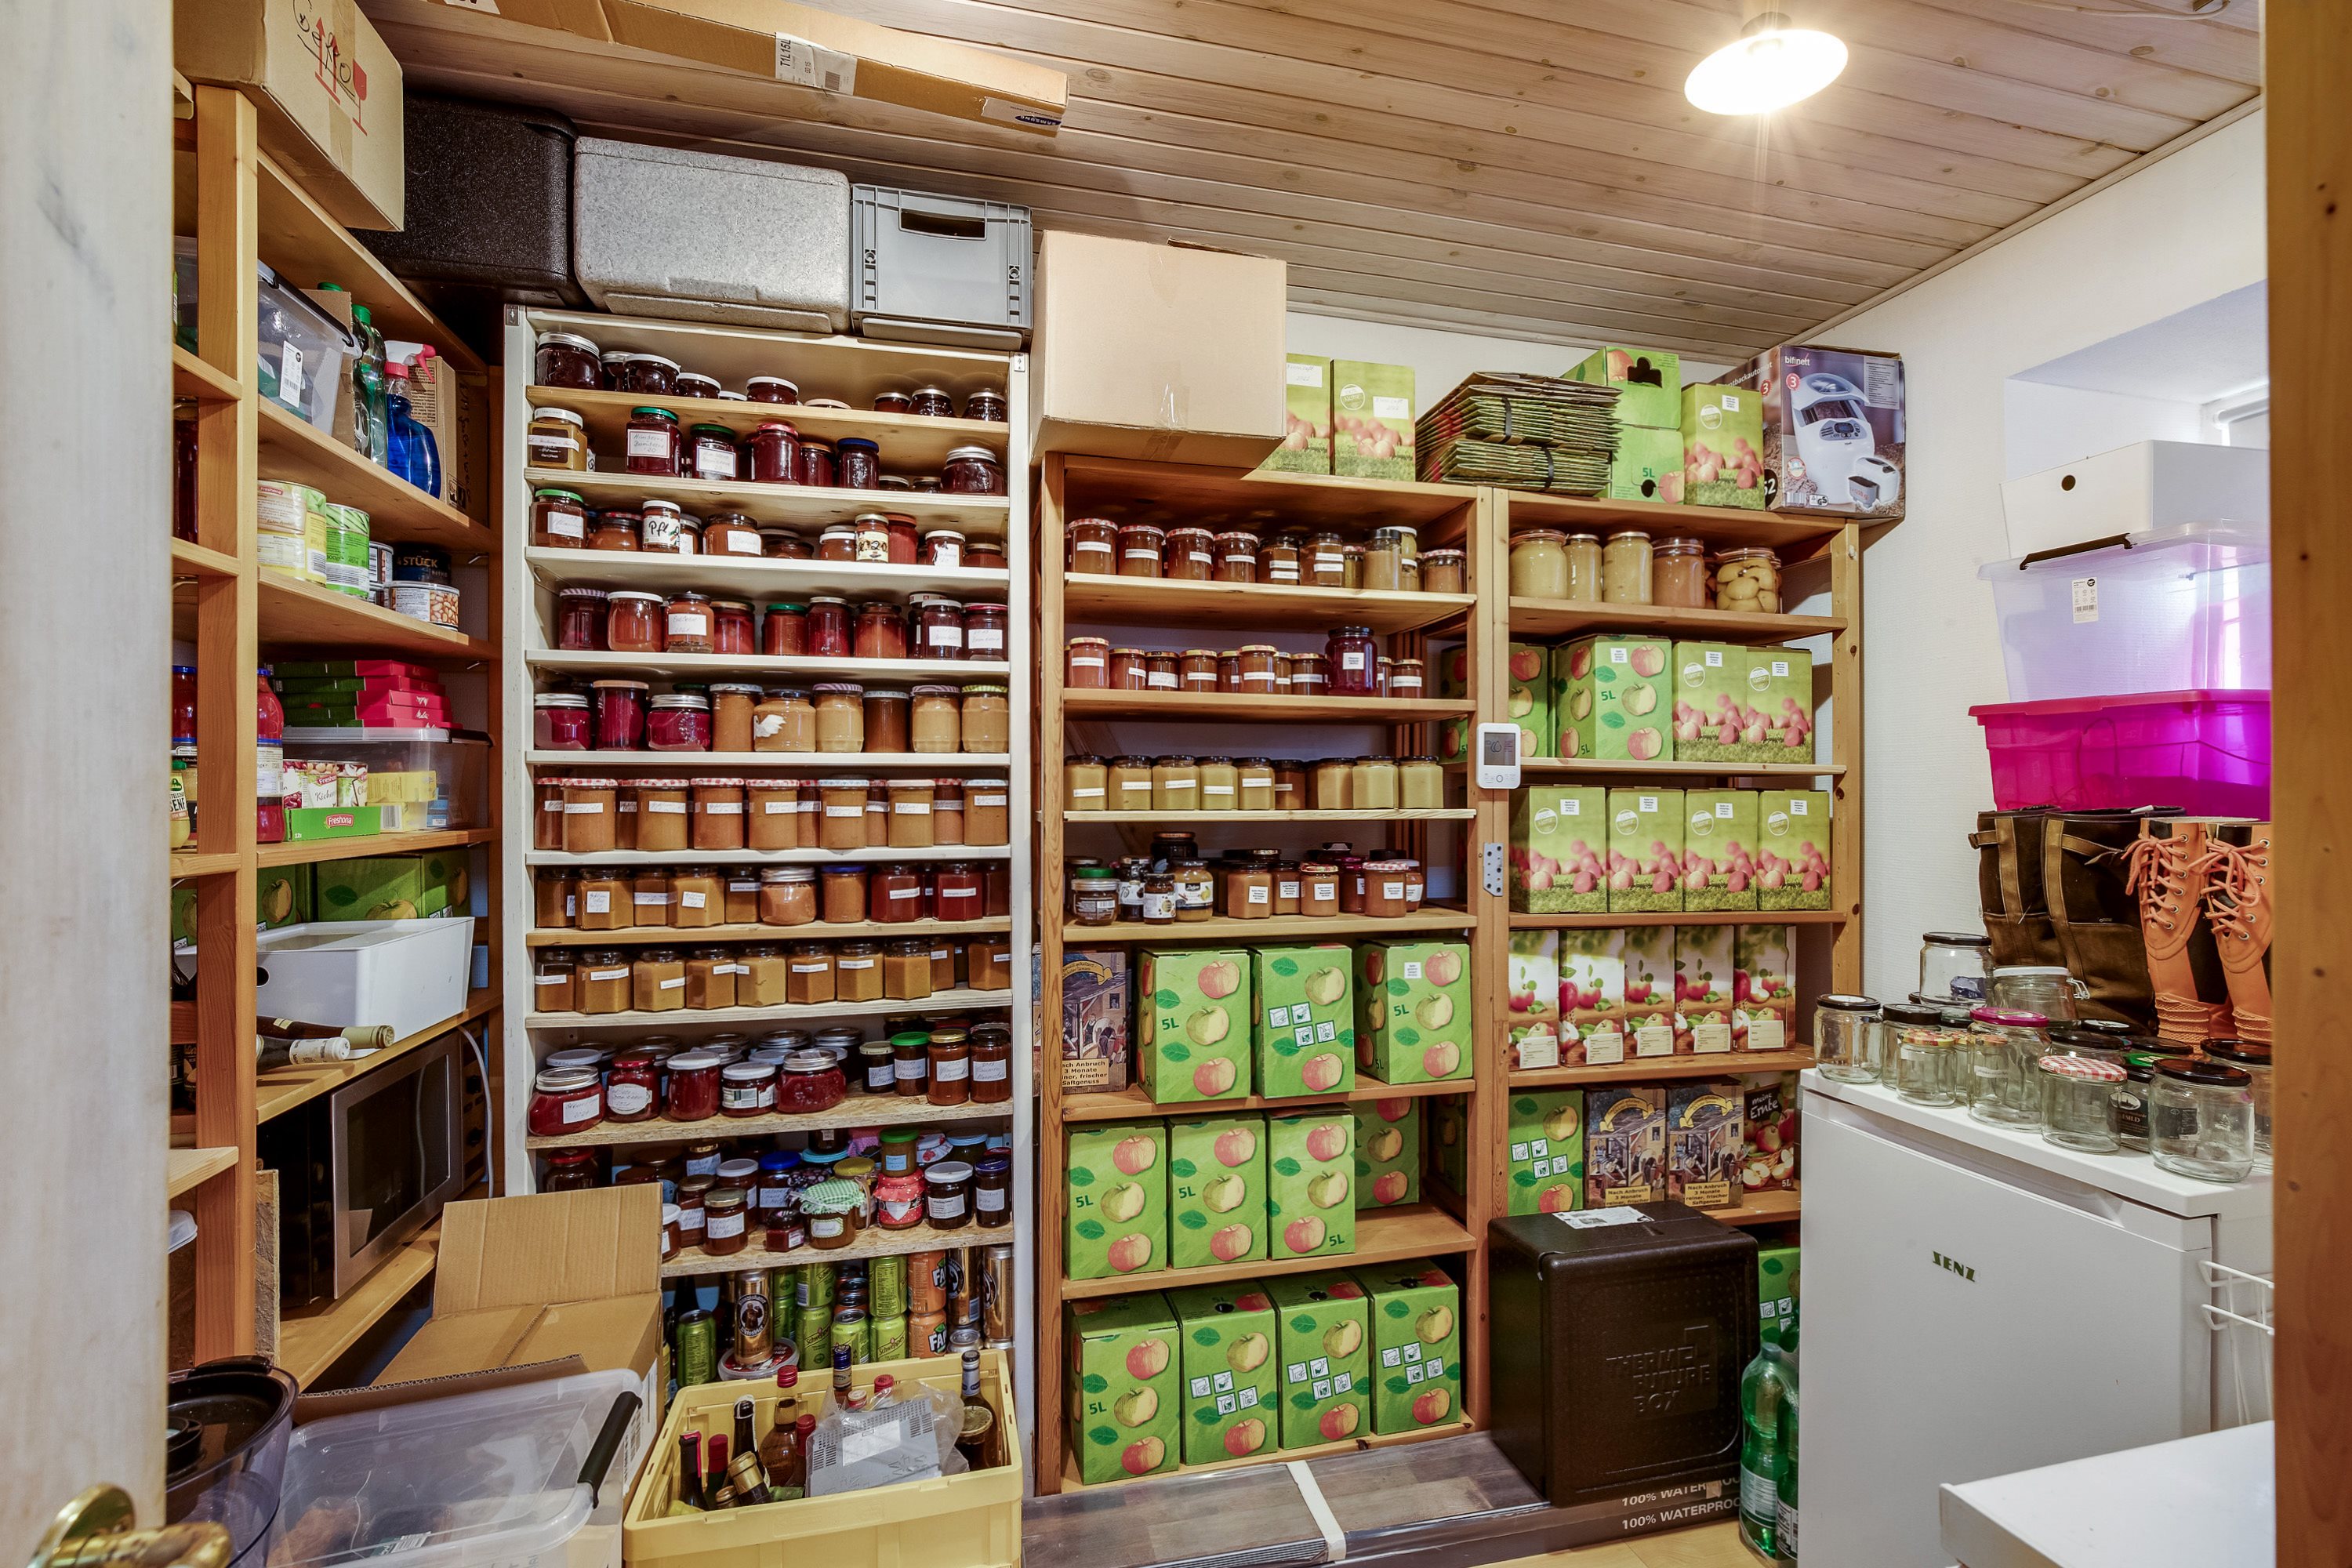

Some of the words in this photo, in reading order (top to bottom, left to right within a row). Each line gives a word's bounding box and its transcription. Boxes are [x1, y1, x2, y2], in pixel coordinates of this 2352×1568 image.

[1642, 467, 1655, 477] 5L
[403, 555, 438, 568] STÜCK
[1601, 689, 1617, 702] 5L
[1581, 744, 1590, 755] 5L
[328, 816, 353, 827] Freshona
[1393, 1004, 1410, 1016] 5L
[1162, 1018, 1180, 1030] 5L
[1374, 1058, 1384, 1070] 5L
[1145, 1075, 1152, 1087] 5L
[1751, 1093, 1773, 1105] meine
[1750, 1099, 1779, 1120] Ernte
[1781, 1178, 1792, 1187] 5L
[1178, 1185, 1196, 1200] 5L
[1076, 1194, 1094, 1208] 5L
[1329, 1234, 1345, 1247] 5L
[877, 1331, 906, 1356] Schweppes
[1088, 1401, 1107, 1415] 5L
[1621, 1493, 1657, 1507] 100%
[1621, 1514, 1657, 1530] 100%
